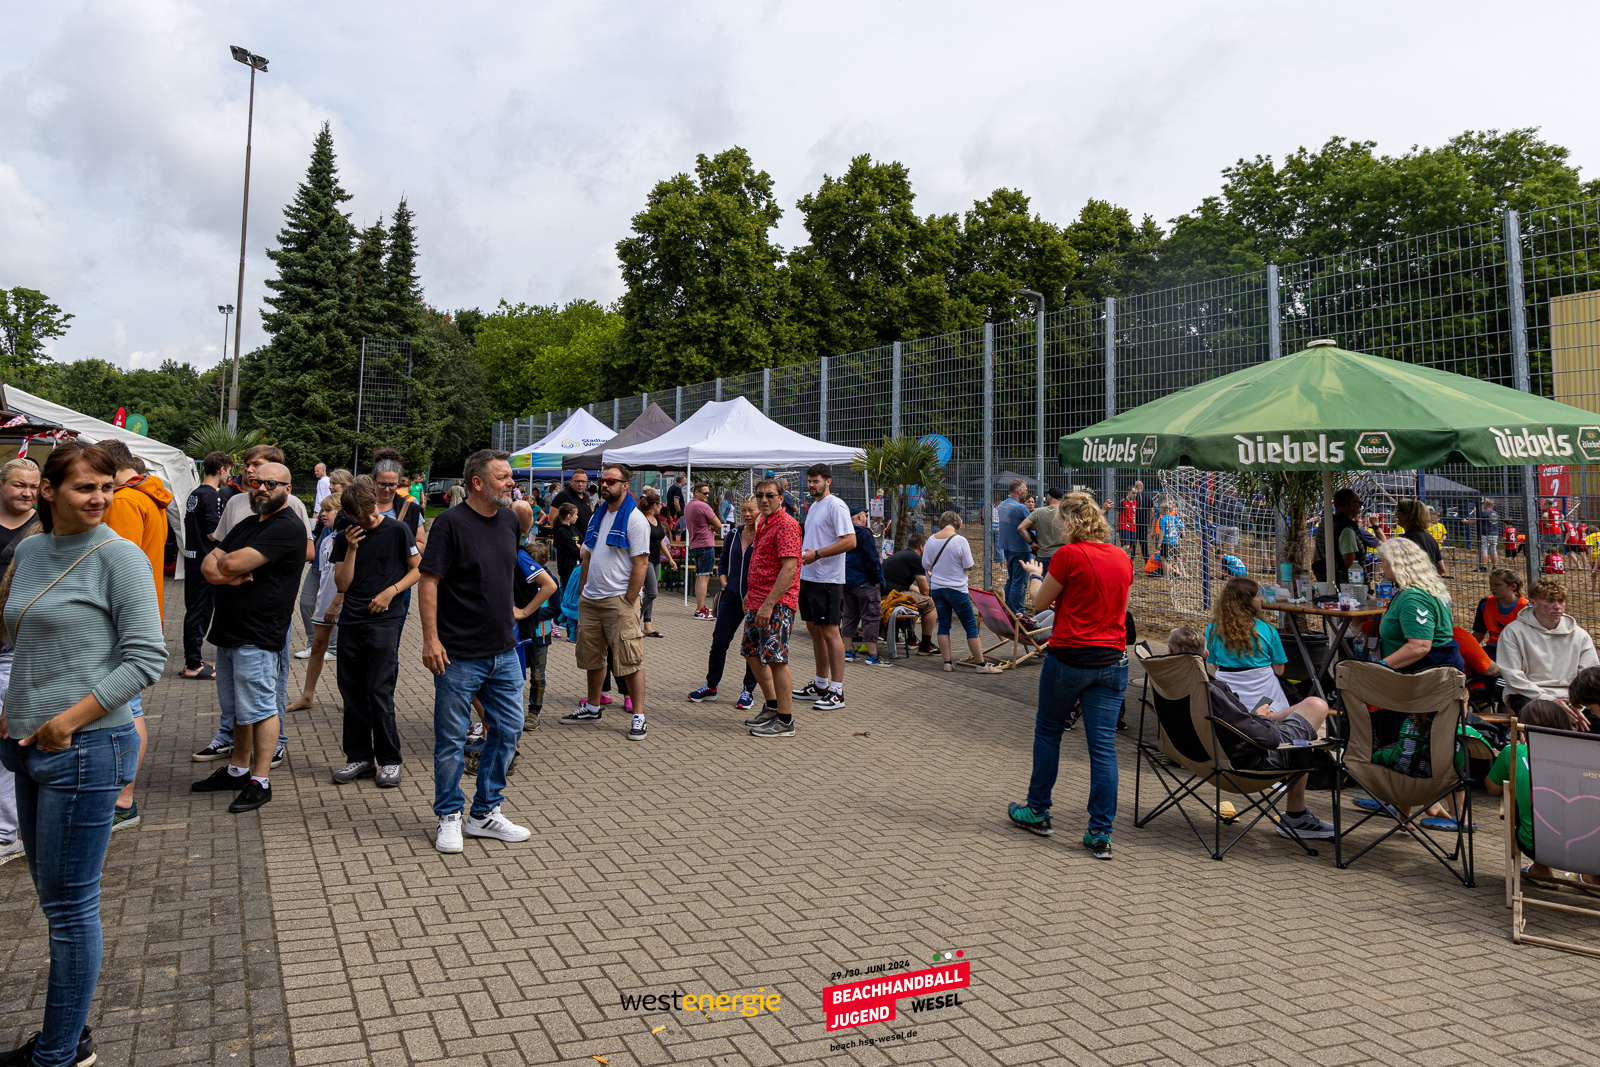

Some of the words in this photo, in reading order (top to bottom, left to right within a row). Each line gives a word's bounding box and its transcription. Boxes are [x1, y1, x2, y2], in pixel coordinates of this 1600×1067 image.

[1083, 436, 1138, 463] Diebels
[1233, 433, 1346, 465] Diebels
[1360, 445, 1389, 454] Diebels
[1488, 426, 1574, 458] Diebels
